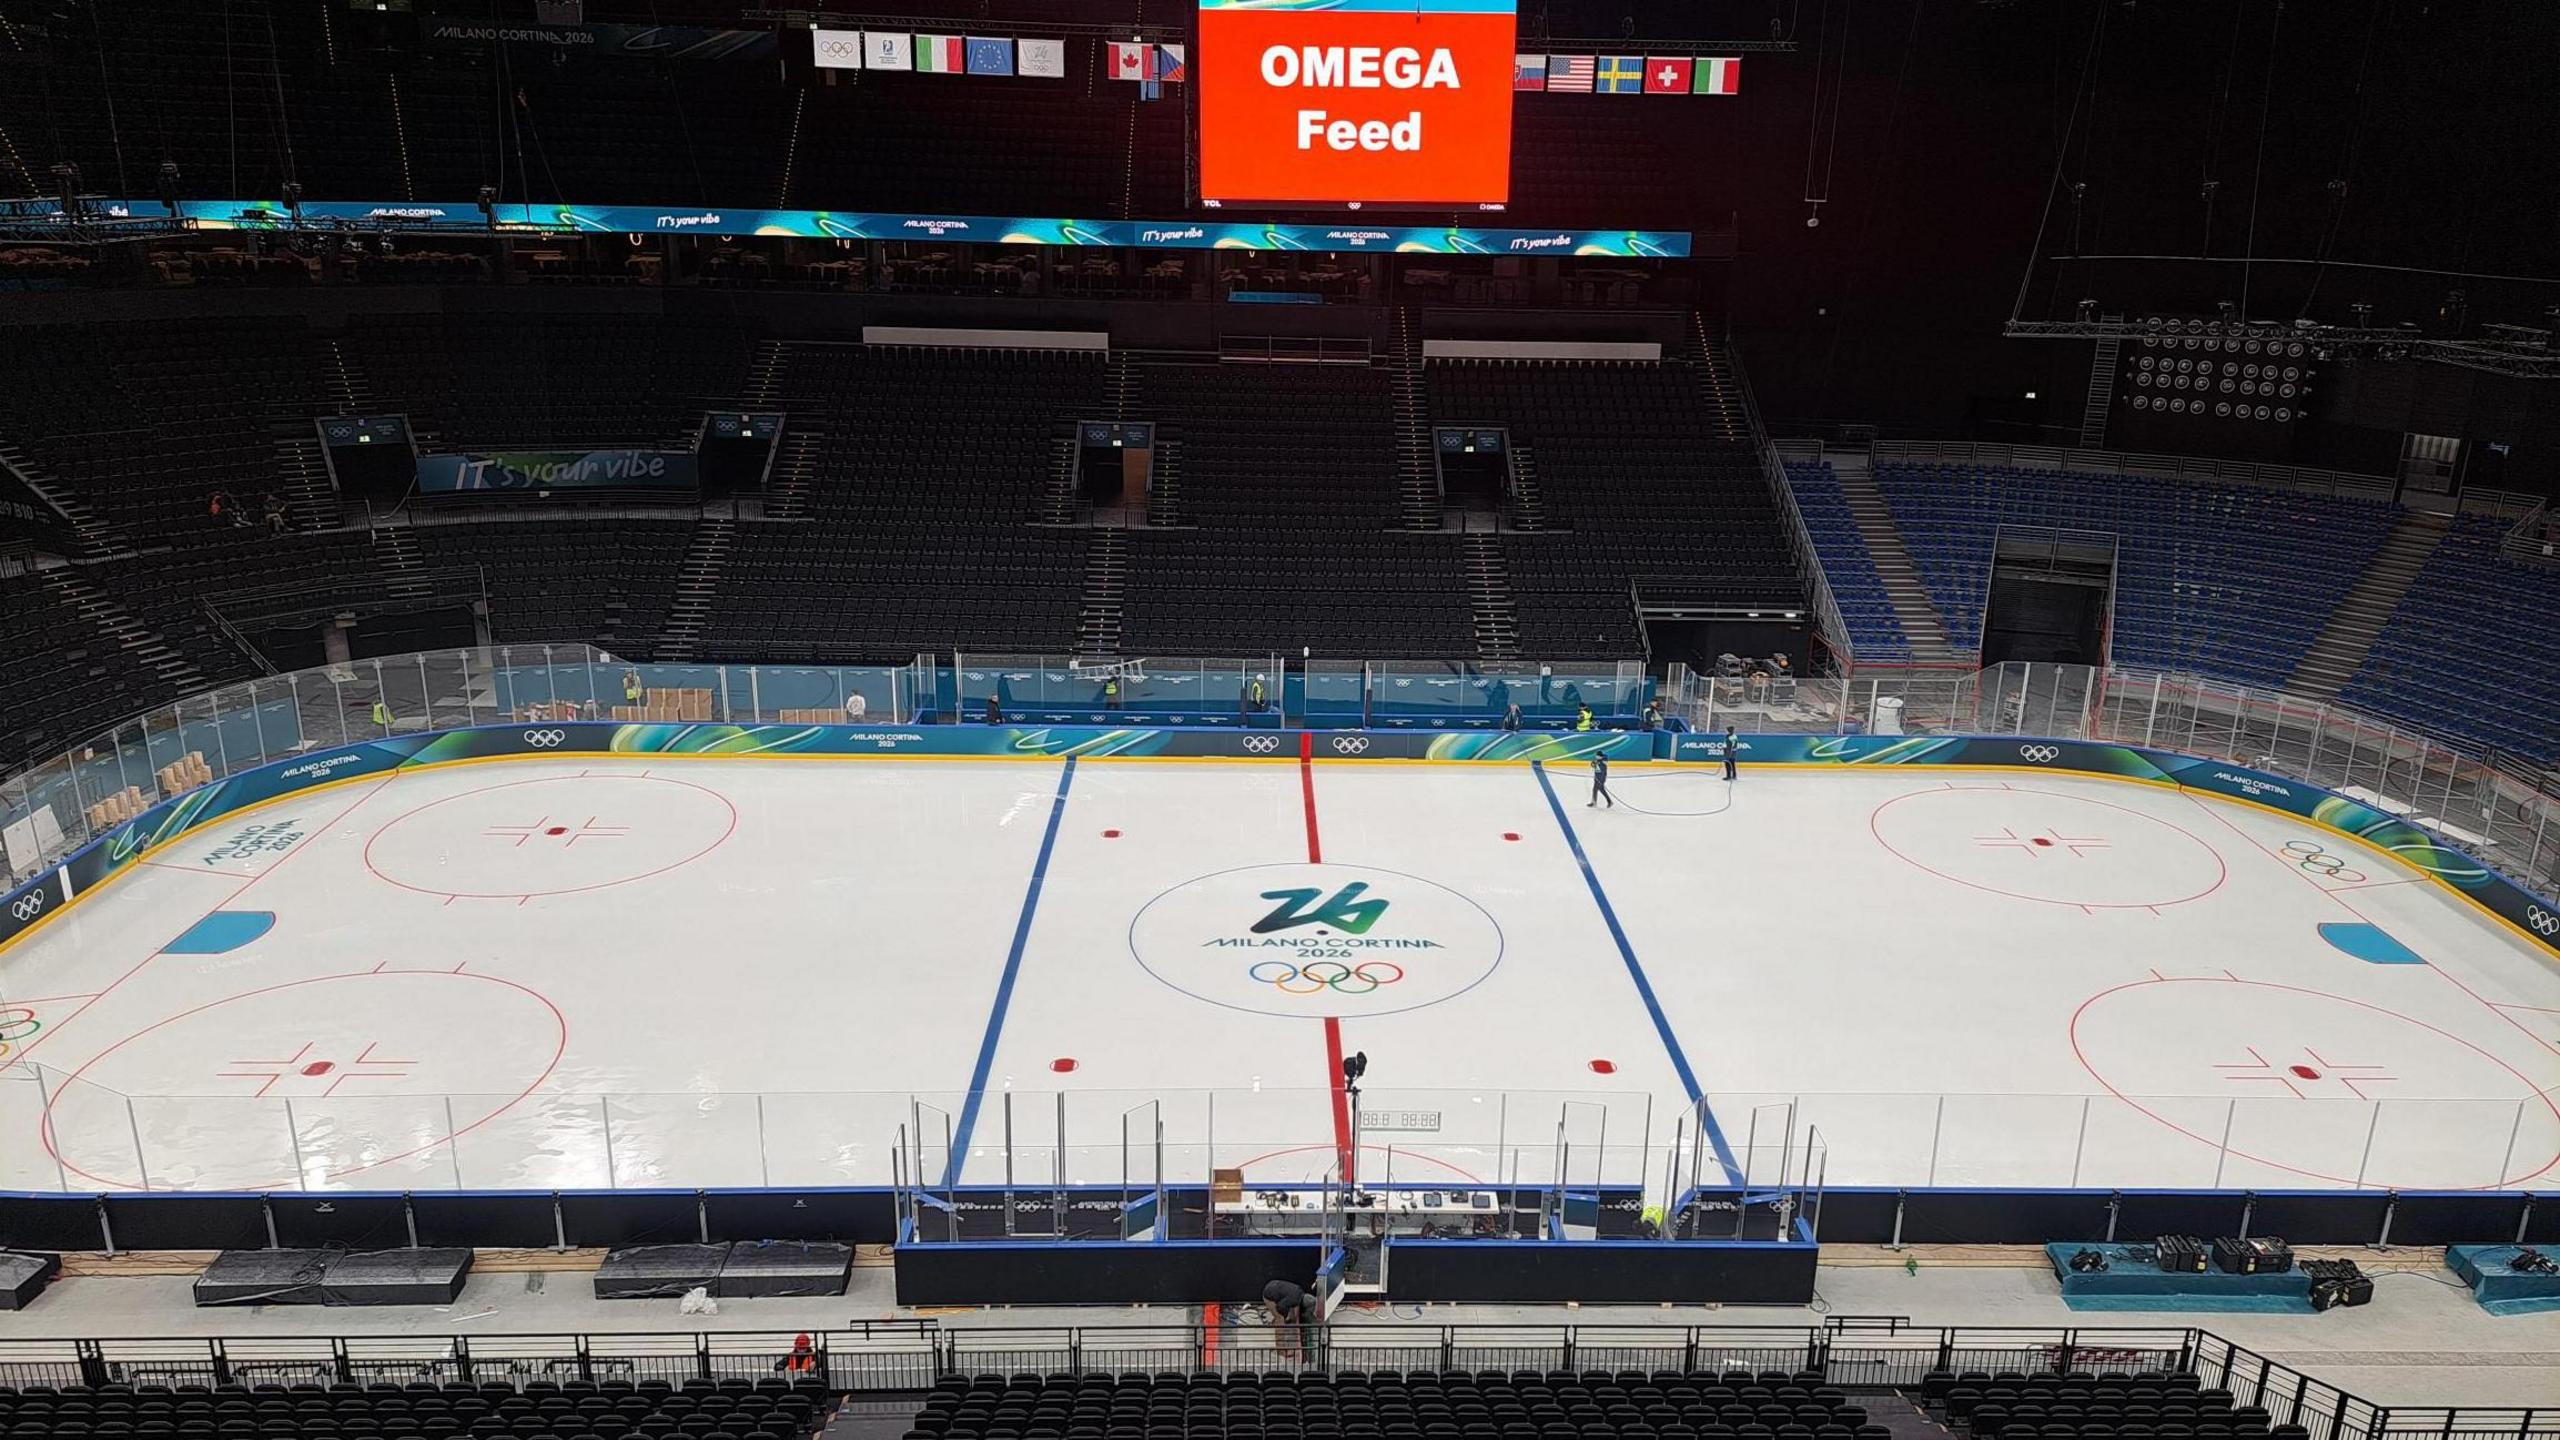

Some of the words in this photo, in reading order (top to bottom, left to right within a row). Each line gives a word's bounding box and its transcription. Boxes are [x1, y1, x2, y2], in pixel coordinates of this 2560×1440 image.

[433, 26, 496, 40] MILANO
[499, 29, 571, 44] CORTINA
[565, 32, 595, 44] 2026
[1261, 44, 1461, 88] OMEGA
[1297, 110, 1421, 151] Feed
[1203, 199, 1222, 207] TCL
[370, 208, 407, 216] MILANO
[408, 208, 446, 217] CORTINA
[657, 216, 676, 228] IT's
[675, 217, 700, 228] your
[701, 213, 720, 224] vibe
[904, 220, 936, 228] MILANO
[936, 221, 968, 230] CORTINA
[1142, 230, 1160, 242] IT's
[1160, 231, 1184, 242] your
[1185, 227, 1203, 238] vibe
[1327, 231, 1357, 239] MILANO
[1358, 232, 1391, 240] CORTINA
[1510, 238, 1528, 250] IT's
[1528, 239, 1552, 250] your
[1552, 235, 1571, 246] vibe
[456, 458, 514, 489] IT's
[522, 459, 598, 489] your
[606, 451, 665, 479] vibe
[849, 733, 886, 741] MILANO
[886, 733, 924, 741] CORTINA
[878, 740, 896, 748] 2026
[281, 762, 319, 779] MILANO
[320, 754, 362, 768] CORTINA
[311, 768, 331, 779] 2026
[2213, 771, 2252, 786] MILANO
[2252, 780, 2290, 797] CORTINA
[2241, 785, 2261, 795] 2026
[203, 825, 266, 865] MILANO
[232, 818, 303, 859] CORTINA
[265, 832, 304, 851] 2026
[1202, 938, 1319, 948] MILANO
[1325, 938, 1446, 949] CORTINA
[1296, 948, 1353, 958] 2026
